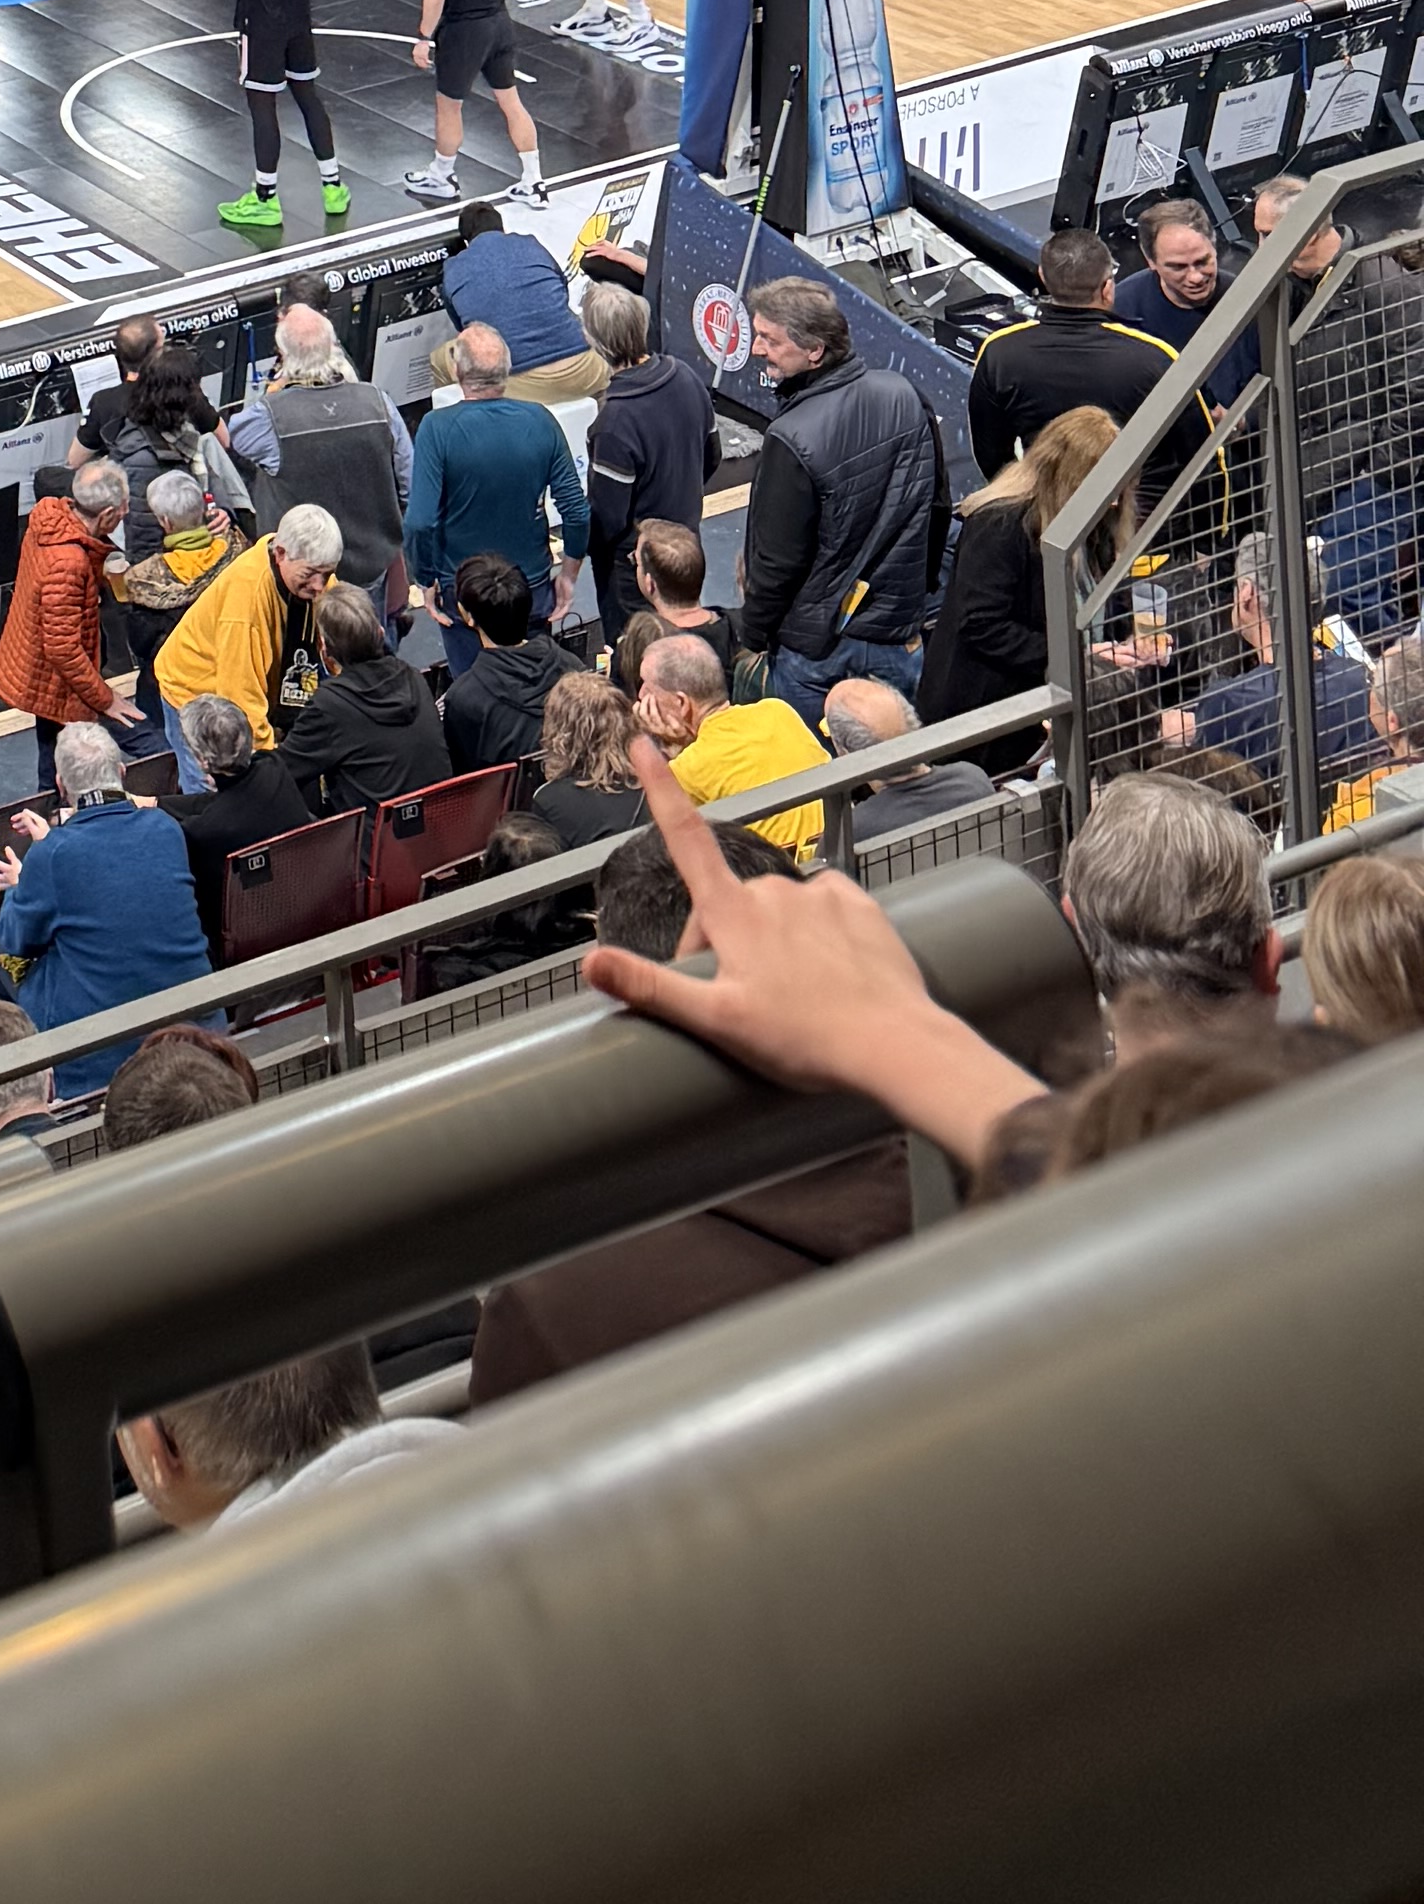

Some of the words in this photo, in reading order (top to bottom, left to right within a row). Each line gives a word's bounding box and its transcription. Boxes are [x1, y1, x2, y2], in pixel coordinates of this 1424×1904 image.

[1110, 55, 1149, 76] Allianz
[1166, 26, 1256, 60] Versicherungsbüro
[1255, 19, 1291, 40] Hoegg
[971, 83, 981, 102] A
[831, 130, 879, 156] SPORT
[347, 262, 392, 286] Global
[393, 245, 450, 274] Investors
[167, 312, 210, 335] Hoegg
[211, 302, 239, 321] oHG
